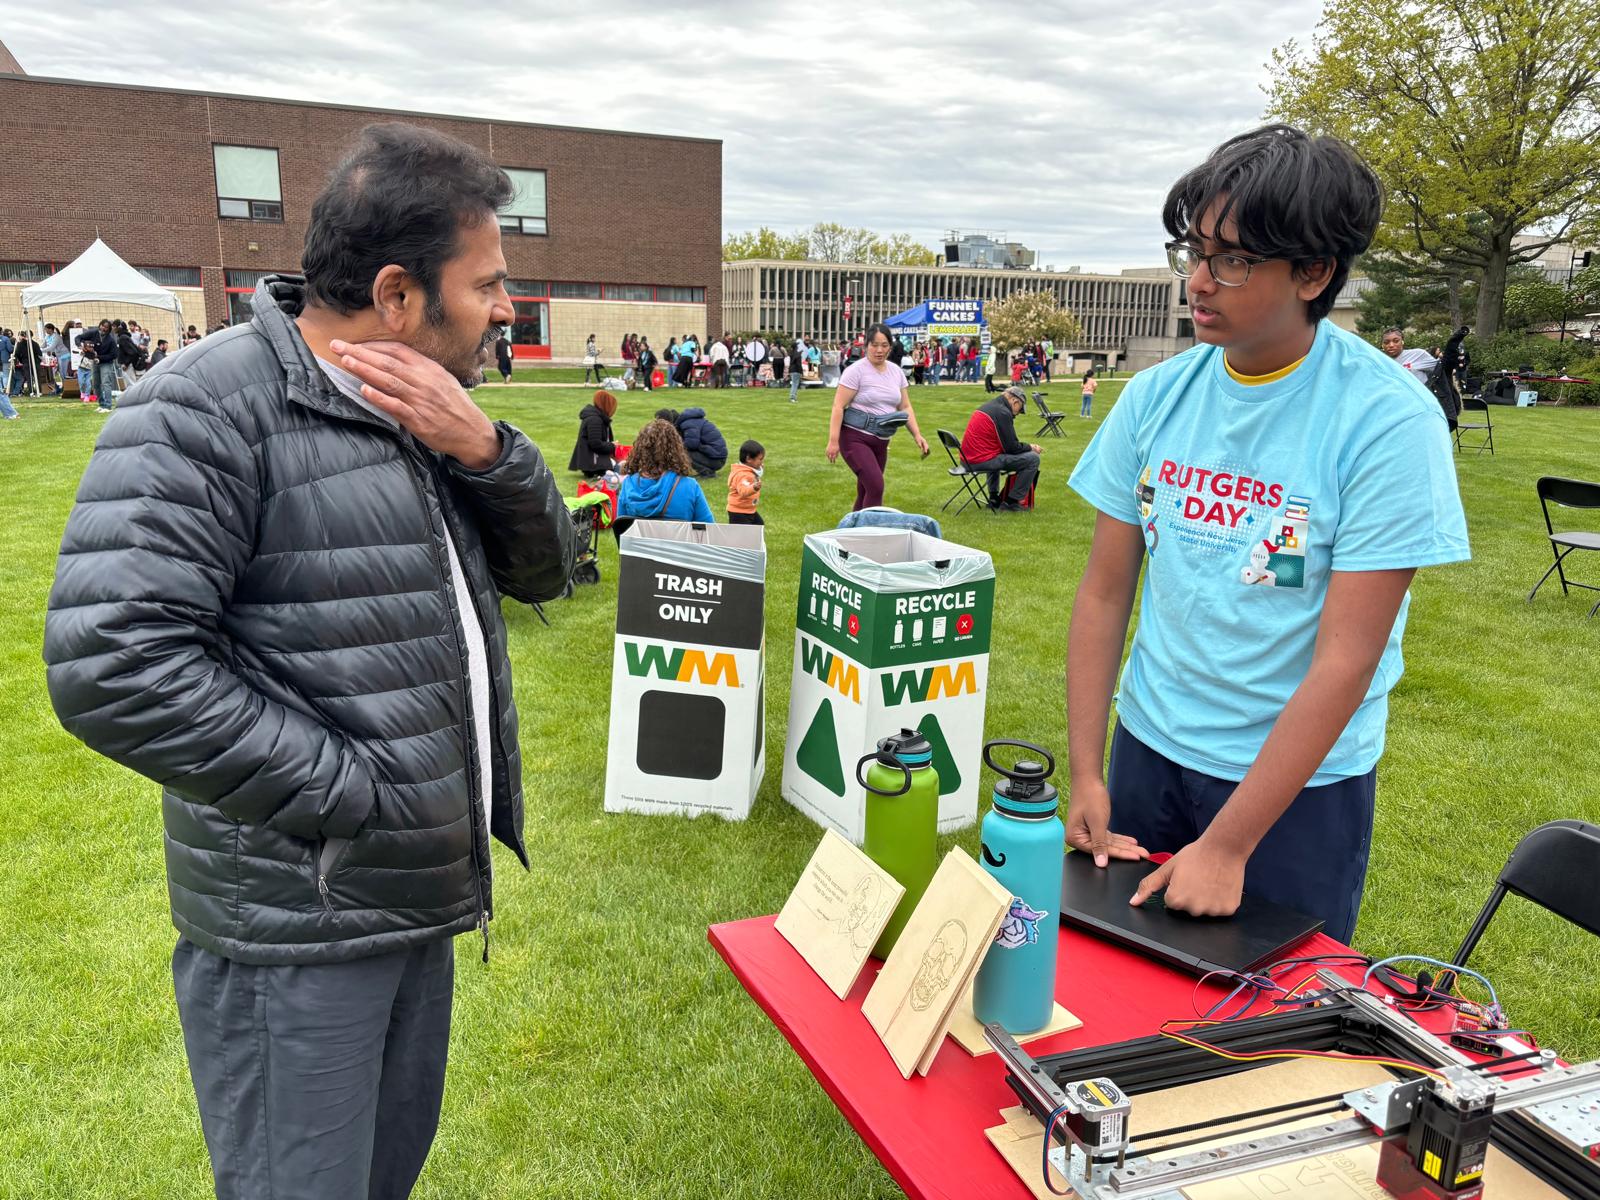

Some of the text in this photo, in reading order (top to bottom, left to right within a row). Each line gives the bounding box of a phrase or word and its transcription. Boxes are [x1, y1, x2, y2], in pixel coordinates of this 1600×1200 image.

[929, 301, 979, 311] FUNNEL
[933, 312, 975, 321] CAKES
[929, 325, 977, 334] LEMONADE
[1157, 459, 1284, 508] RUTGERS
[1184, 496, 1248, 528] DAY
[1169, 522, 1248, 546] Experience New Jersey
[1179, 534, 1238, 553] State University
[654, 573, 722, 596] TRASH
[812, 572, 862, 611] RECYCLE
[658, 604, 713, 624] ONLY
[896, 590, 976, 615] RECYCLE
[624, 642, 740, 688] WM
[801, 636, 860, 704] WM
[880, 661, 977, 707] WM
